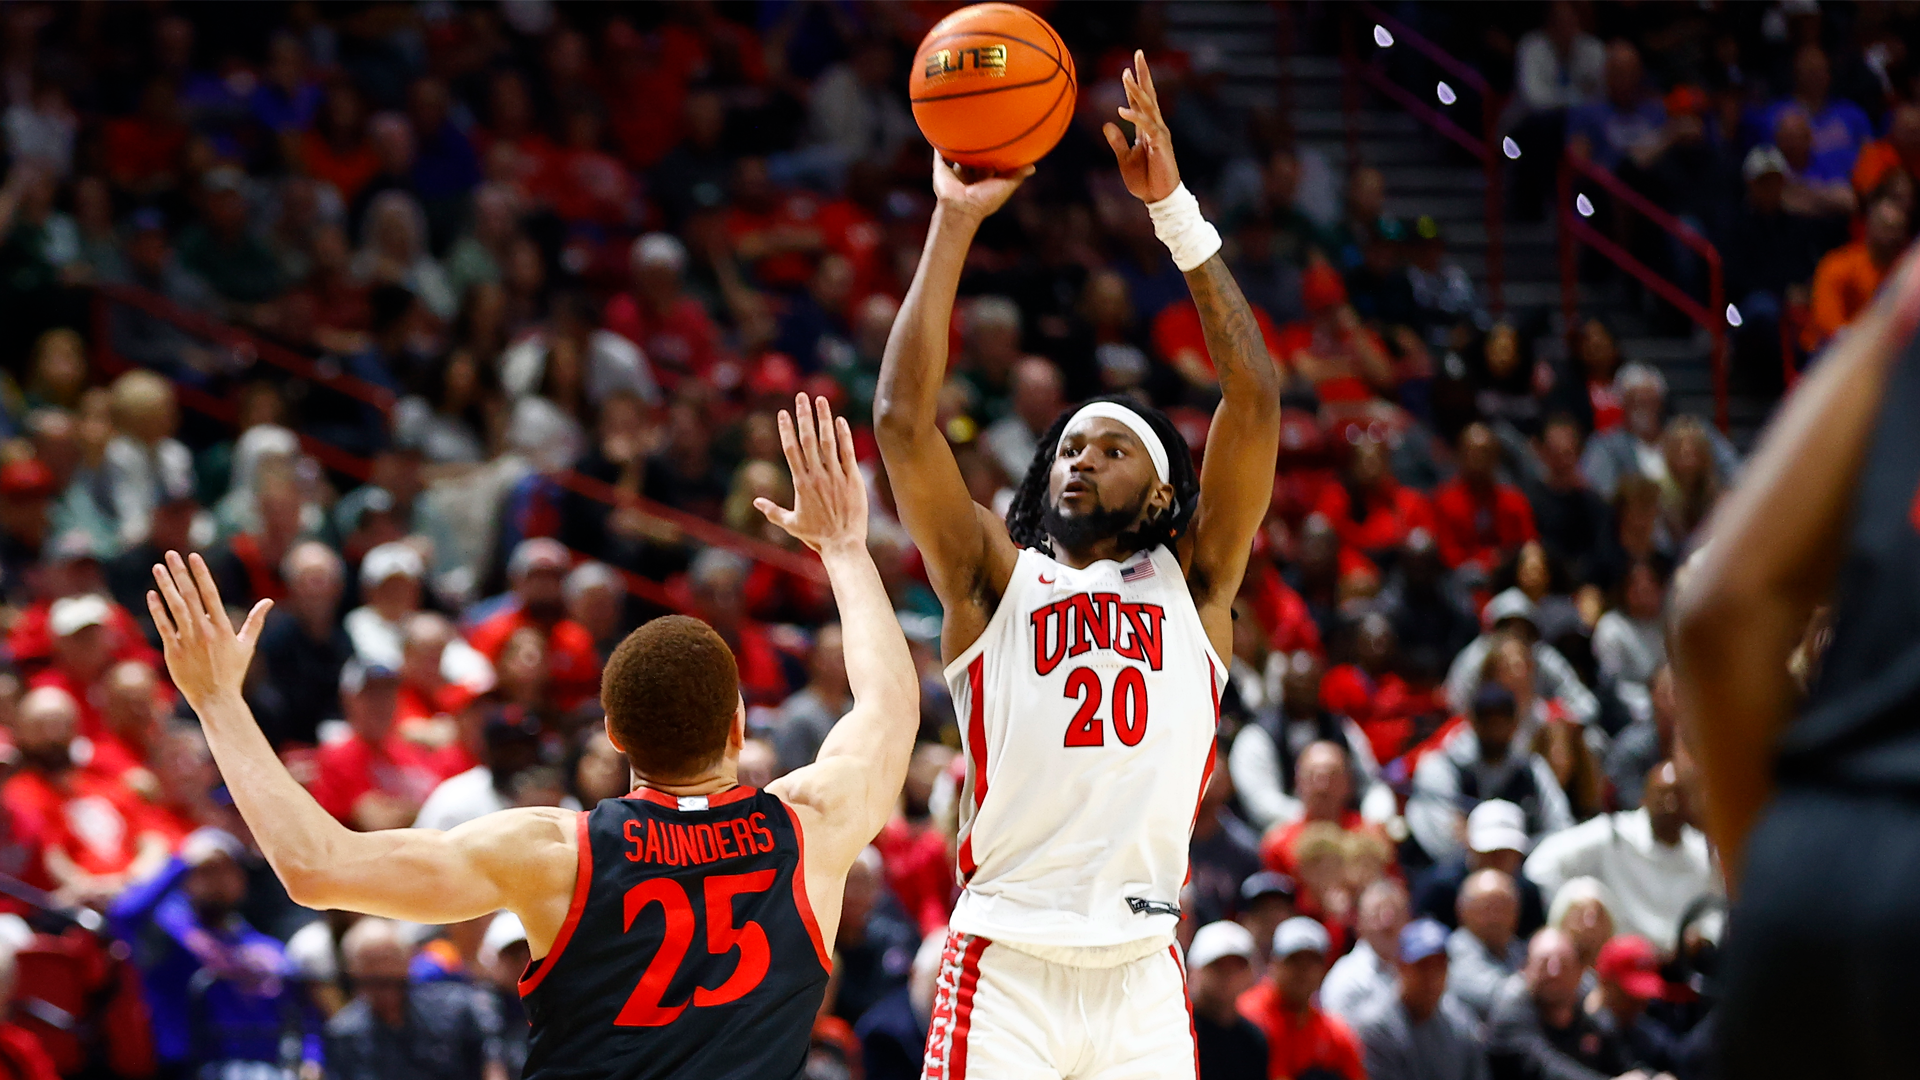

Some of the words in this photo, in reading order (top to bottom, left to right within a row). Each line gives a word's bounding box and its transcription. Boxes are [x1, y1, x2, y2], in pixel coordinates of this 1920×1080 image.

[925, 44, 1006, 79] ELITE
[1030, 592, 1166, 676] UNLV
[1064, 666, 1148, 747] 20
[623, 811, 775, 866] SAUNDERS
[613, 868, 777, 1026] 25
